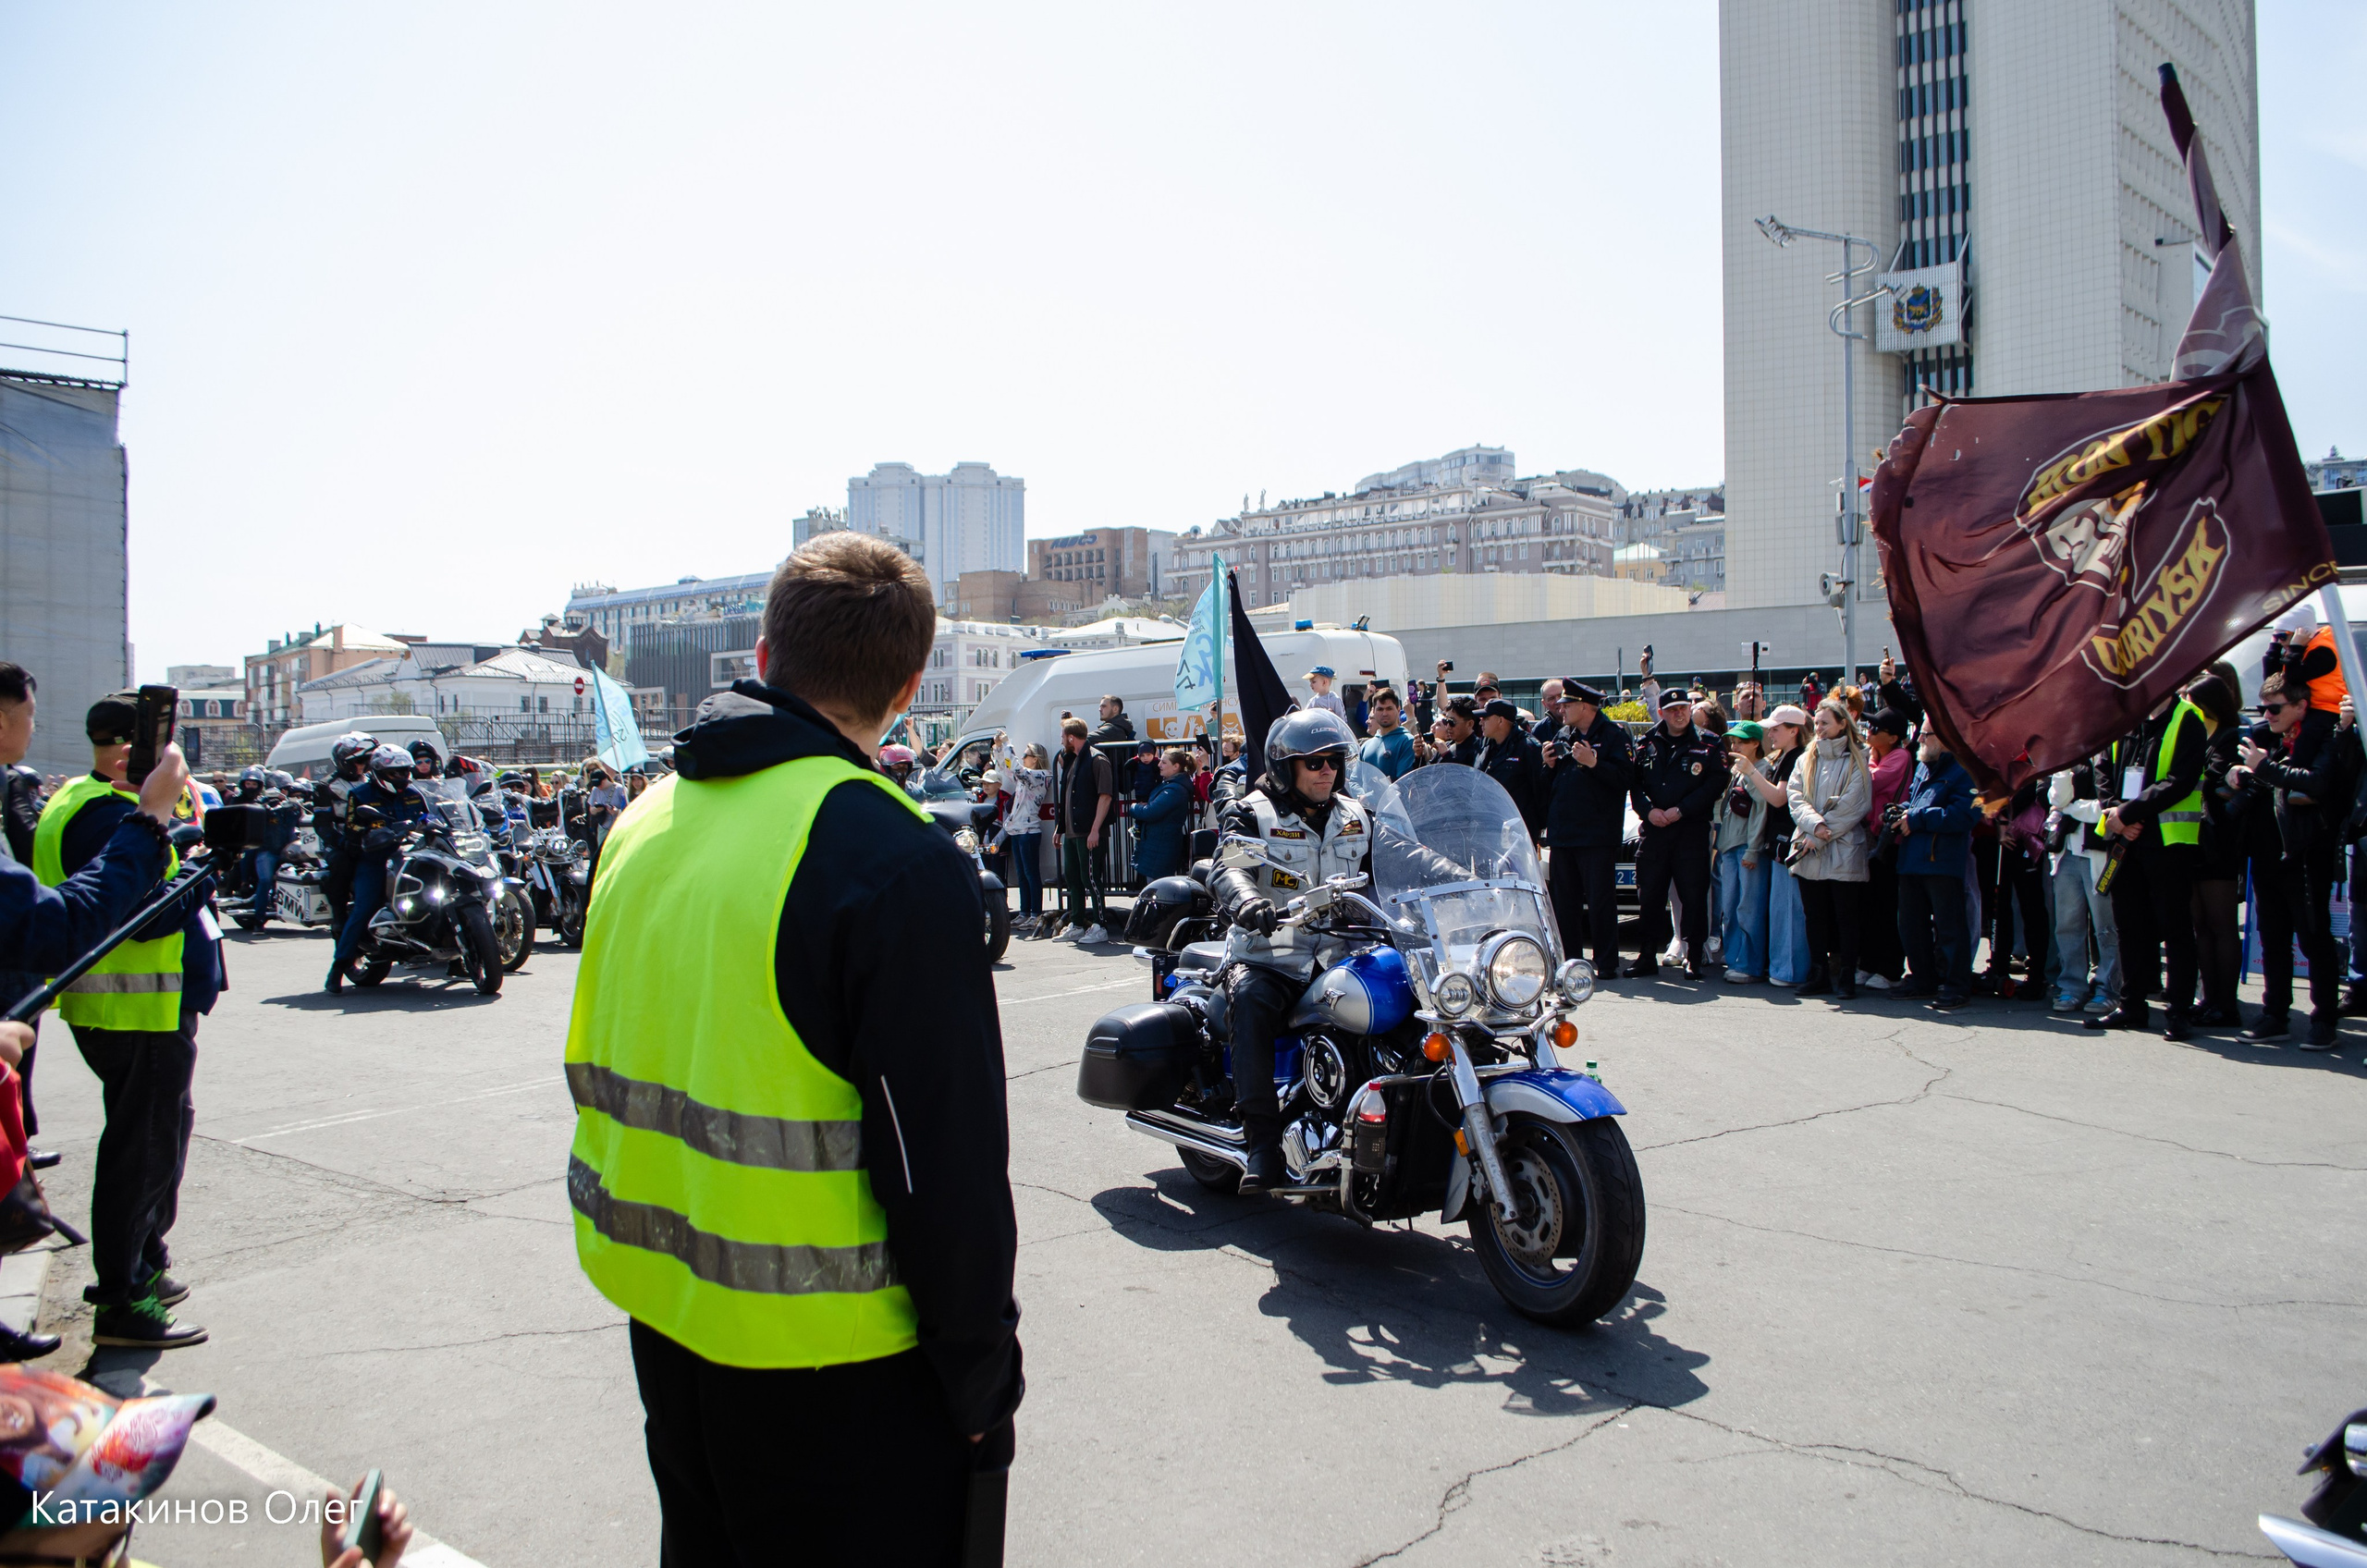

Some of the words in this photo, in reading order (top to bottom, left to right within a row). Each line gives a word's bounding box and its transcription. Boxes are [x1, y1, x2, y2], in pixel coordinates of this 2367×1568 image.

[1276, 829, 1301, 839] ХАРЛИ
[1275, 874, 1296, 887] MC
[277, 888, 305, 921] BMW
